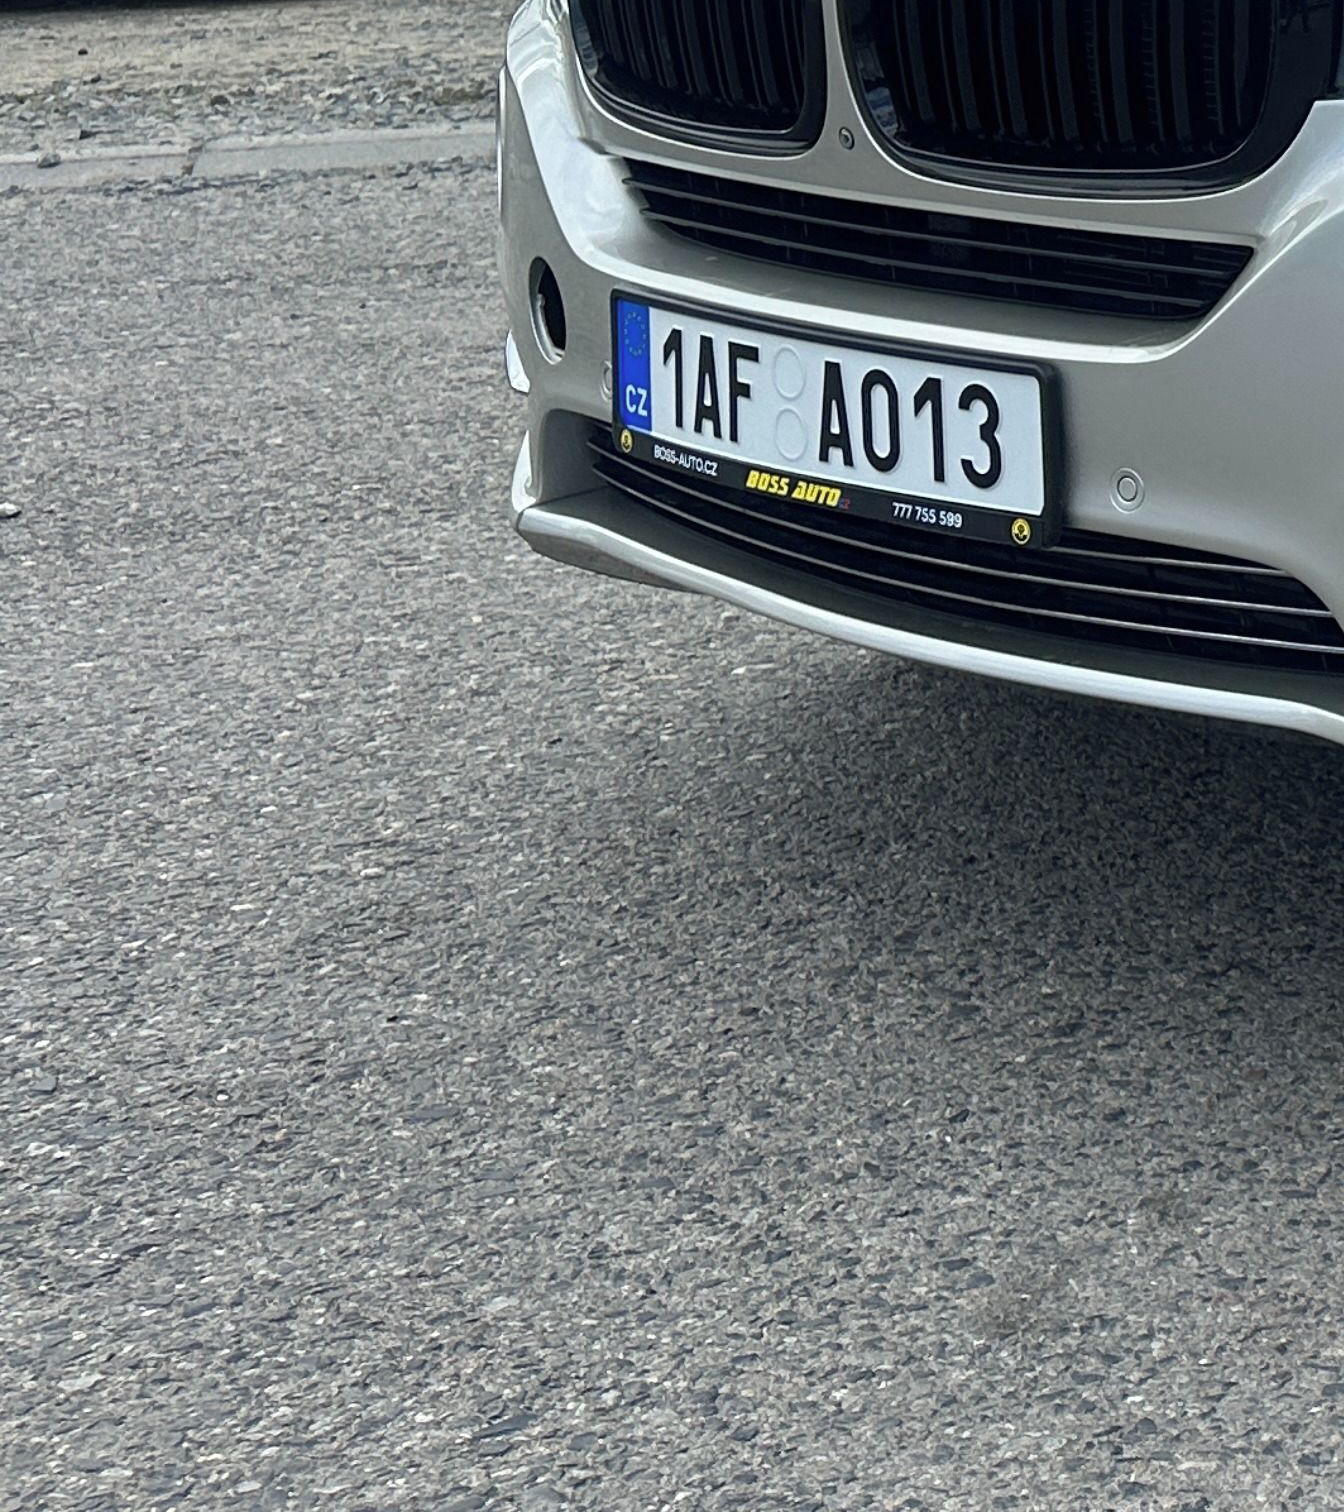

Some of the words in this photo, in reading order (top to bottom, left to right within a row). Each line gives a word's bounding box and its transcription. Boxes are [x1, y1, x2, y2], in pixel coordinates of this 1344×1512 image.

[625, 384, 648, 417] CZ
[662, 327, 760, 443] 1AF
[818, 359, 1002, 489] A013
[654, 444, 719, 477] BOSS-AUTO.CZ
[746, 470, 789, 495] BOSS
[791, 481, 842, 508] AUTO
[892, 501, 913, 520] 777
[914, 505, 937, 524] 755
[938, 510, 963, 528] 599
